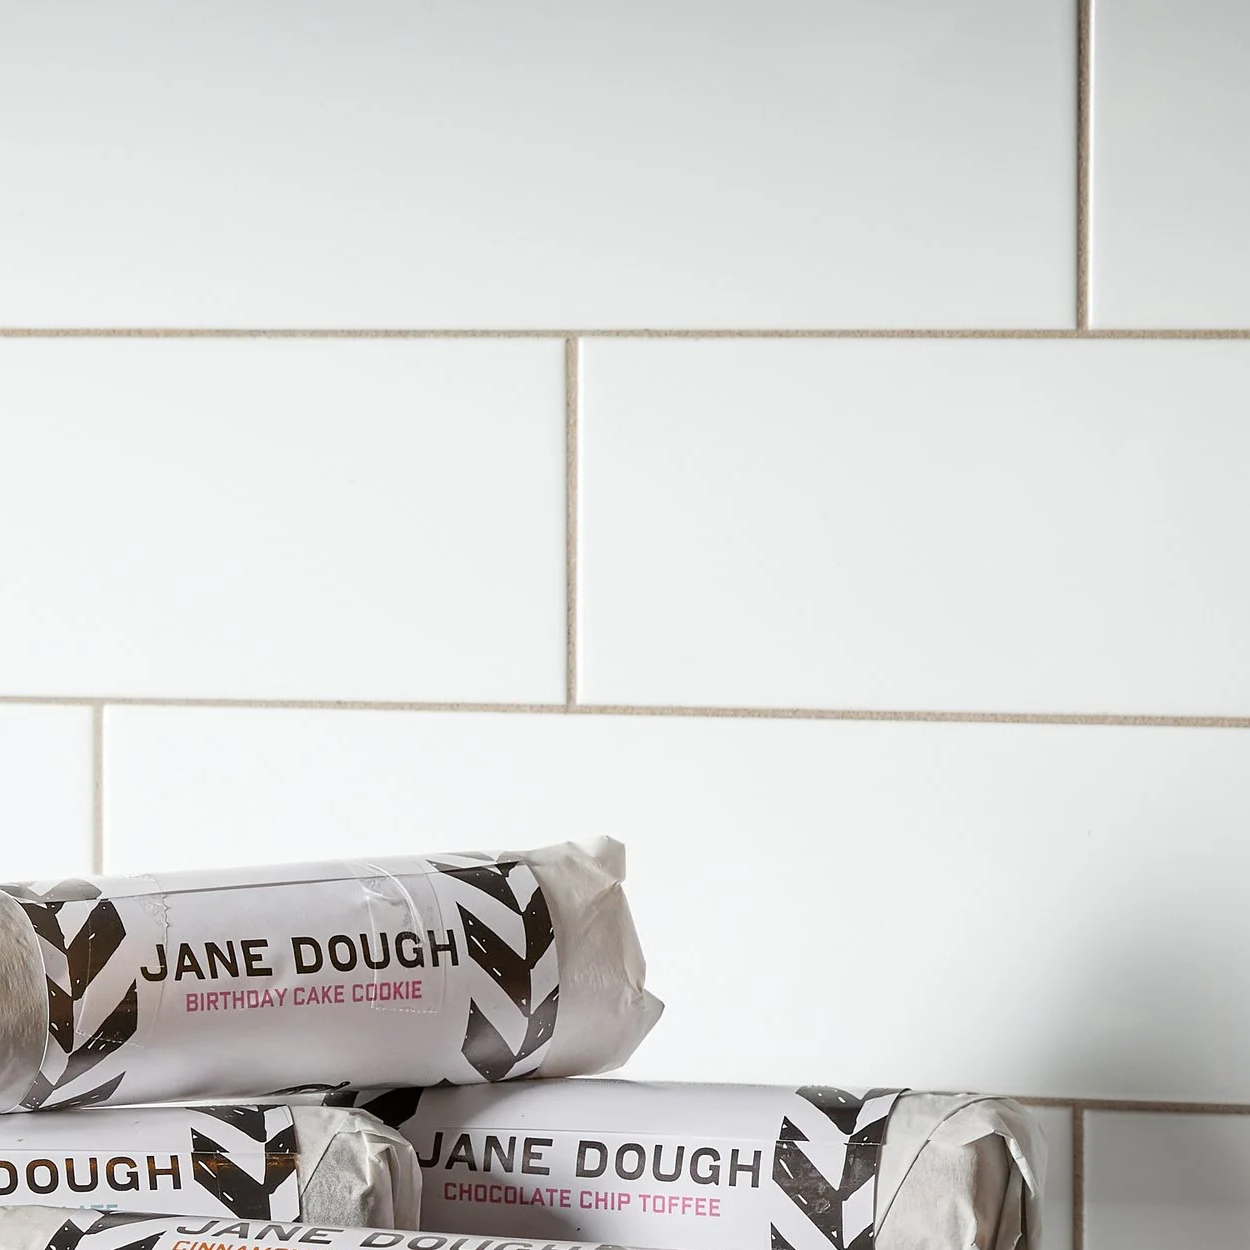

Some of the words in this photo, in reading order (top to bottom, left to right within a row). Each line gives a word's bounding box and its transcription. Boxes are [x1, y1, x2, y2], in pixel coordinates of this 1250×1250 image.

[140, 938, 273, 982] JANE
[291, 928, 459, 975] DOUGH
[186, 988, 287, 1012] BIRTHDAY
[293, 985, 344, 1006] CAKE
[352, 980, 422, 1003] COOKIE
[416, 1131, 554, 1176] JANE
[575, 1140, 762, 1188] DOUGH
[444, 1182, 571, 1208] CHOCOLATE
[580, 1190, 631, 1211] CHIP
[639, 1194, 721, 1217] TOFFEE
[176, 1219, 343, 1246] JANE
